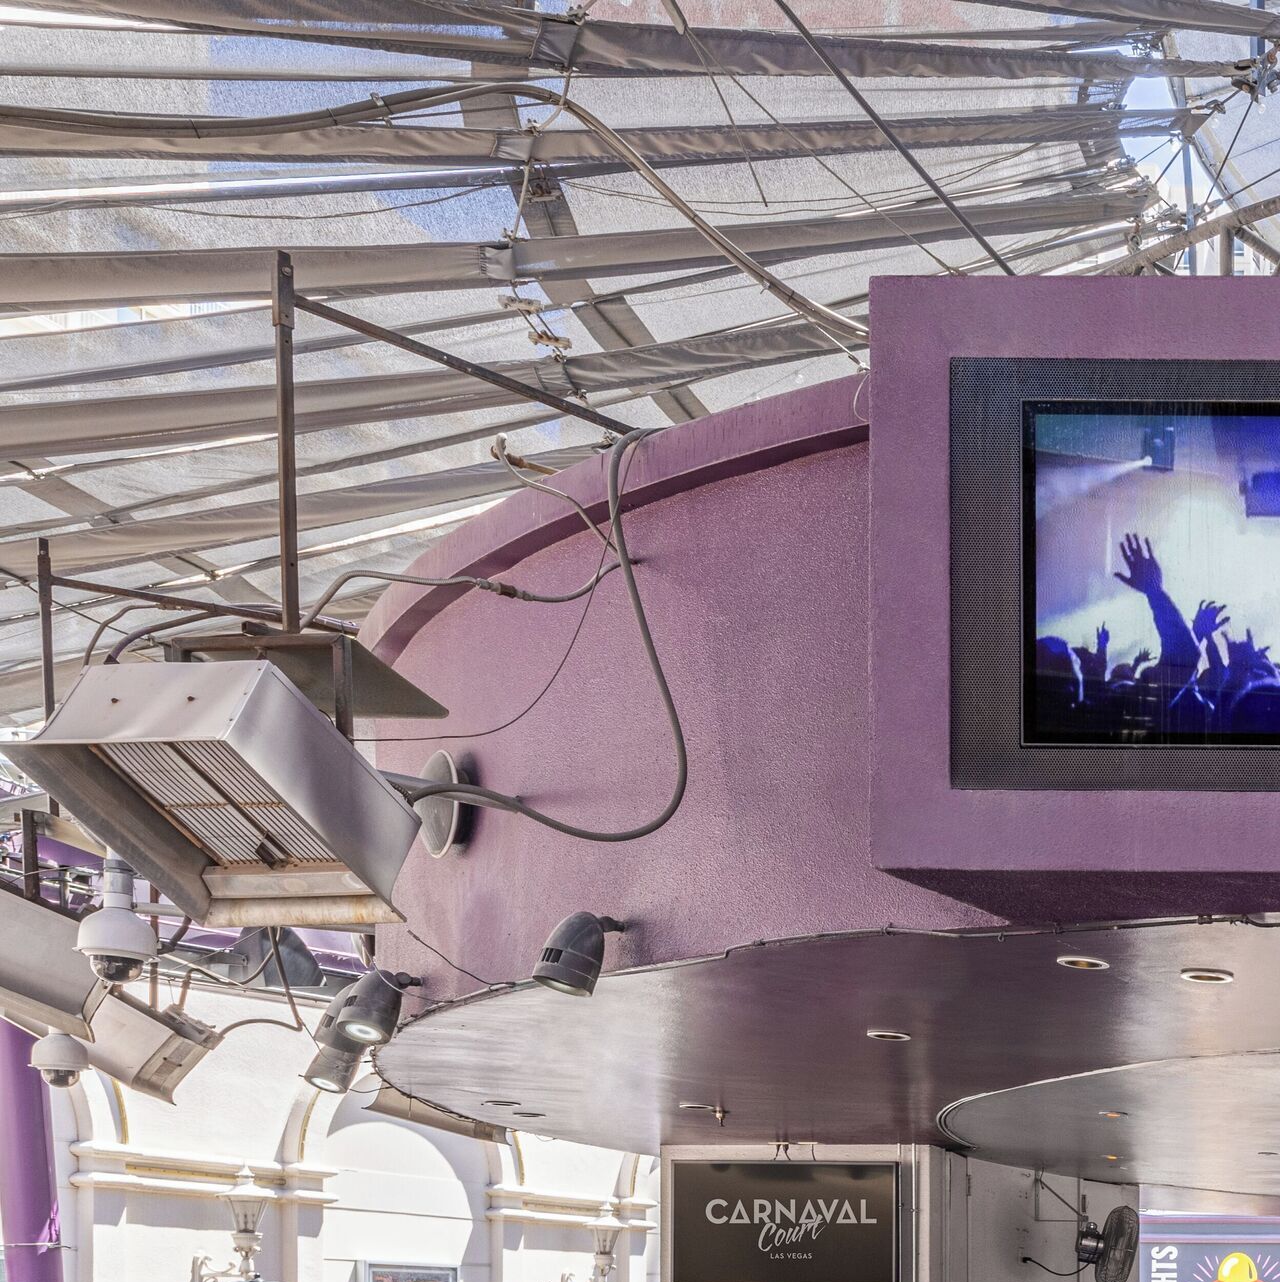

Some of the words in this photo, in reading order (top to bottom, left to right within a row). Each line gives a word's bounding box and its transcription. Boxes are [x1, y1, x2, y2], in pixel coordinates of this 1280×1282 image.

[705, 1198, 878, 1225] CARNAVAL
[758, 1213, 826, 1252] Court
[770, 1252, 785, 1260] LAS
[786, 1252, 813, 1260] VEGAS
